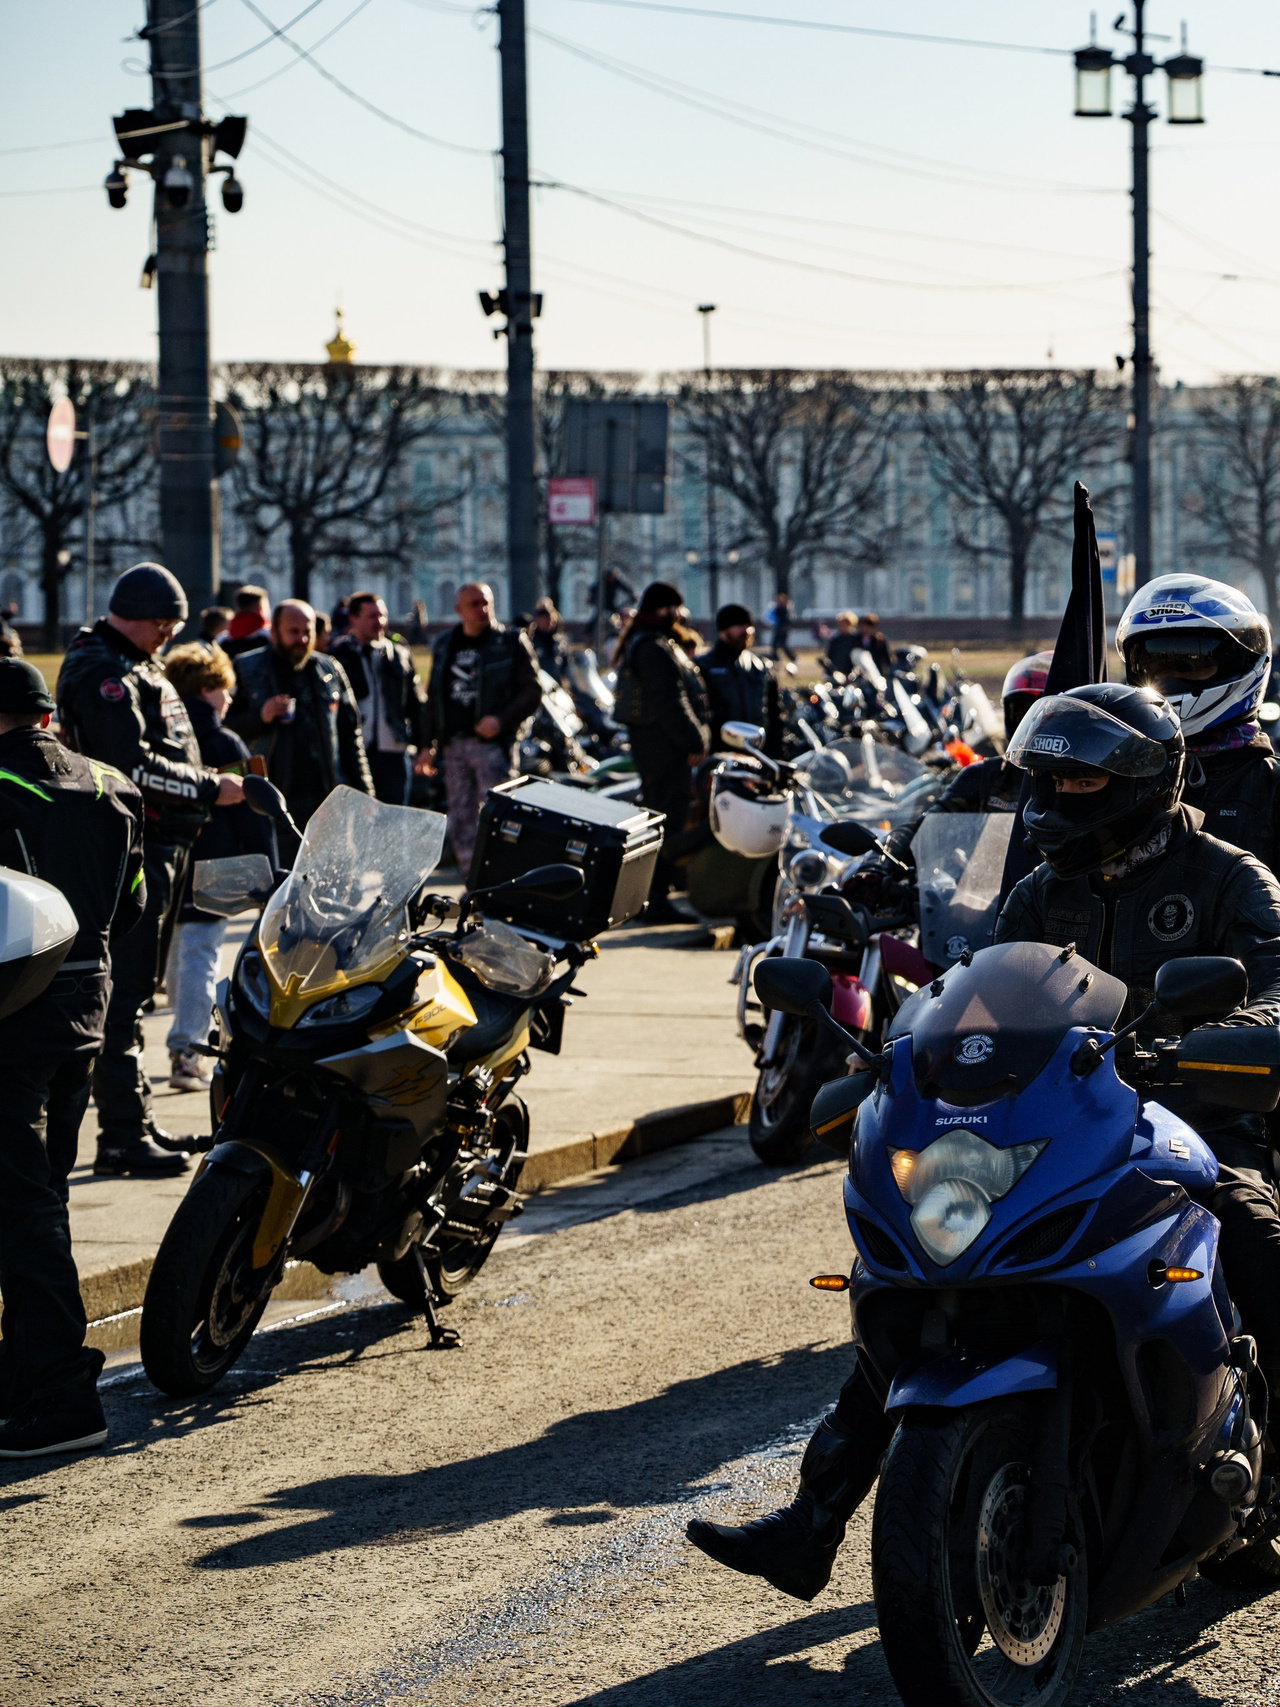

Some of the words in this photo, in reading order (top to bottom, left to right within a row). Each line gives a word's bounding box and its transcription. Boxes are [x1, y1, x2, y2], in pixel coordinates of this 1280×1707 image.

[1149, 603, 1186, 617] SHOEI
[1032, 737, 1065, 752] SHOEI
[935, 1116, 988, 1126] SUZUKI
